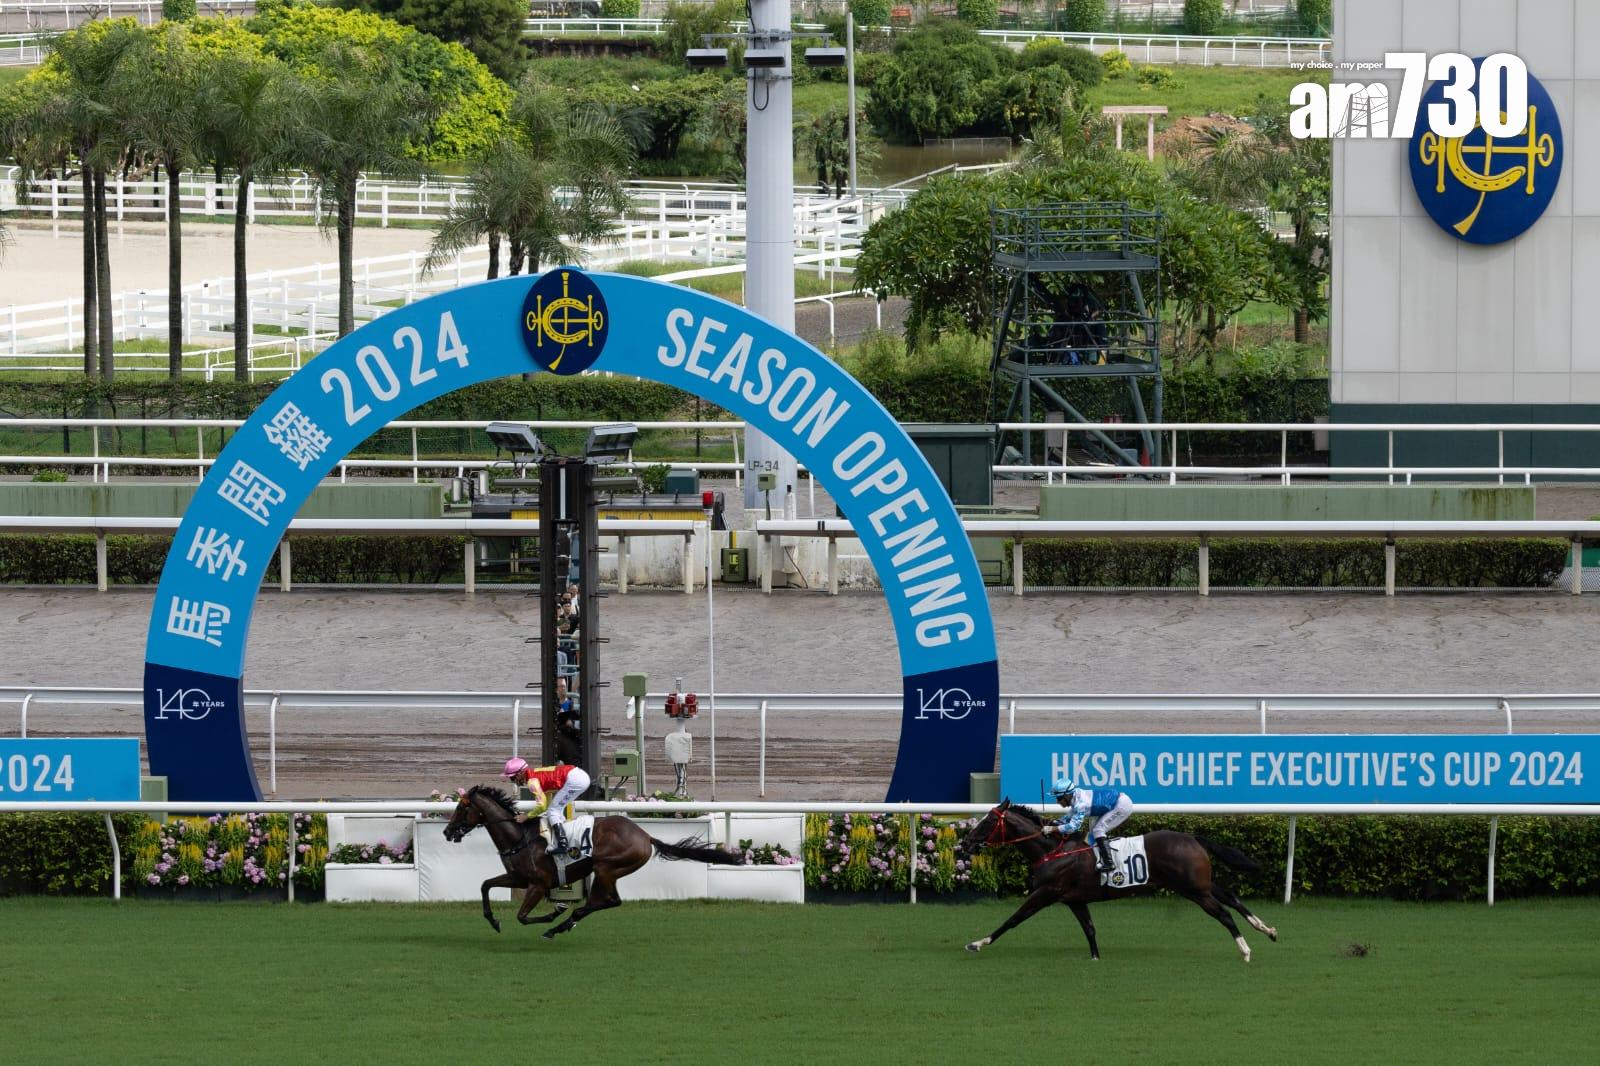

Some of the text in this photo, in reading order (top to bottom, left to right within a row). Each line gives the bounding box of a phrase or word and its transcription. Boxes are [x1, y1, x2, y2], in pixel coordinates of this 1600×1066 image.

[320, 310, 470, 427] 2024
[657, 308, 975, 648] SEASON OPENING
[748, 460, 779, 471] LP-34
[0, 754, 75, 792] 024
[1051, 752, 1147, 787] HKSAR
[1157, 752, 1242, 787] CHIEF
[1444, 752, 1501, 787] CUP
[1509, 751, 1584, 786] 2024
[1124, 853, 1147, 884] 10
